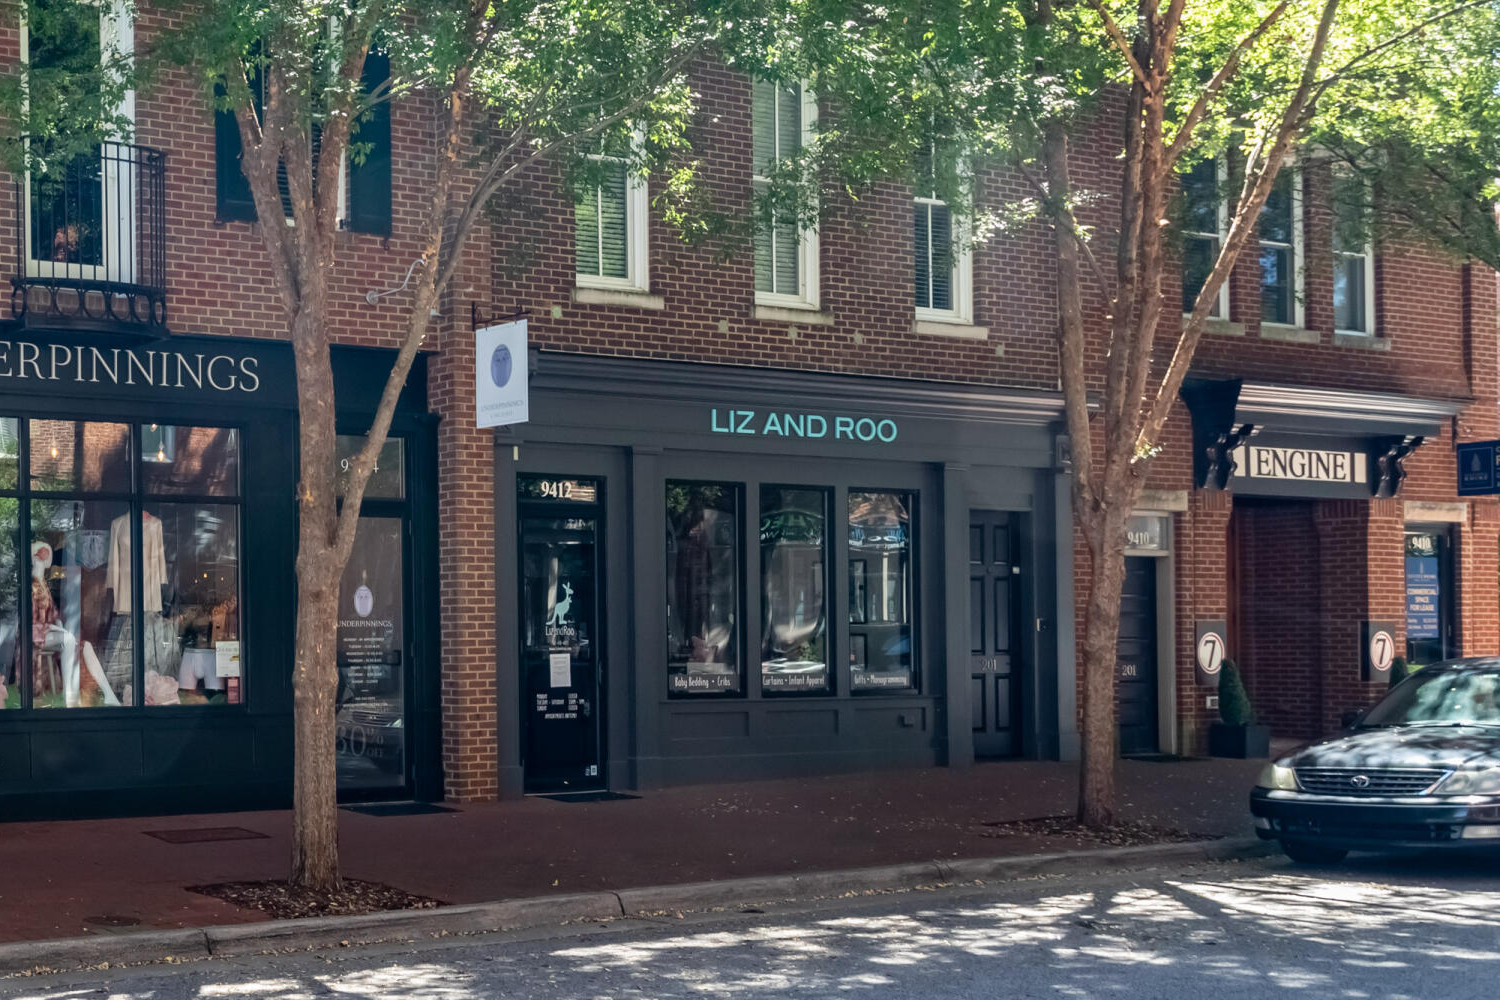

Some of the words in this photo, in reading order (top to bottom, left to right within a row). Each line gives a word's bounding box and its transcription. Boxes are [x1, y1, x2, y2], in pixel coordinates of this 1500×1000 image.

[711, 409, 756, 434] LIZ
[762, 413, 828, 438] AND
[835, 416, 898, 442] ROO
[1255, 448, 1347, 480] ENGINE
[541, 480, 573, 498] 9412
[1127, 531, 1150, 545] 9410
[1412, 536, 1432, 549] 9410
[336, 620, 392, 628] UNDERPINNINGS
[1204, 640, 1216, 668] 7
[1376, 638, 1387, 665] 7
[1122, 665, 1136, 676] 201
[674, 676, 688, 689] Baby
[689, 676, 709, 689] Bedding
[717, 676, 731, 686] Cribs
[763, 675, 784, 686] Curtains
[788, 675, 804, 685] Infant
